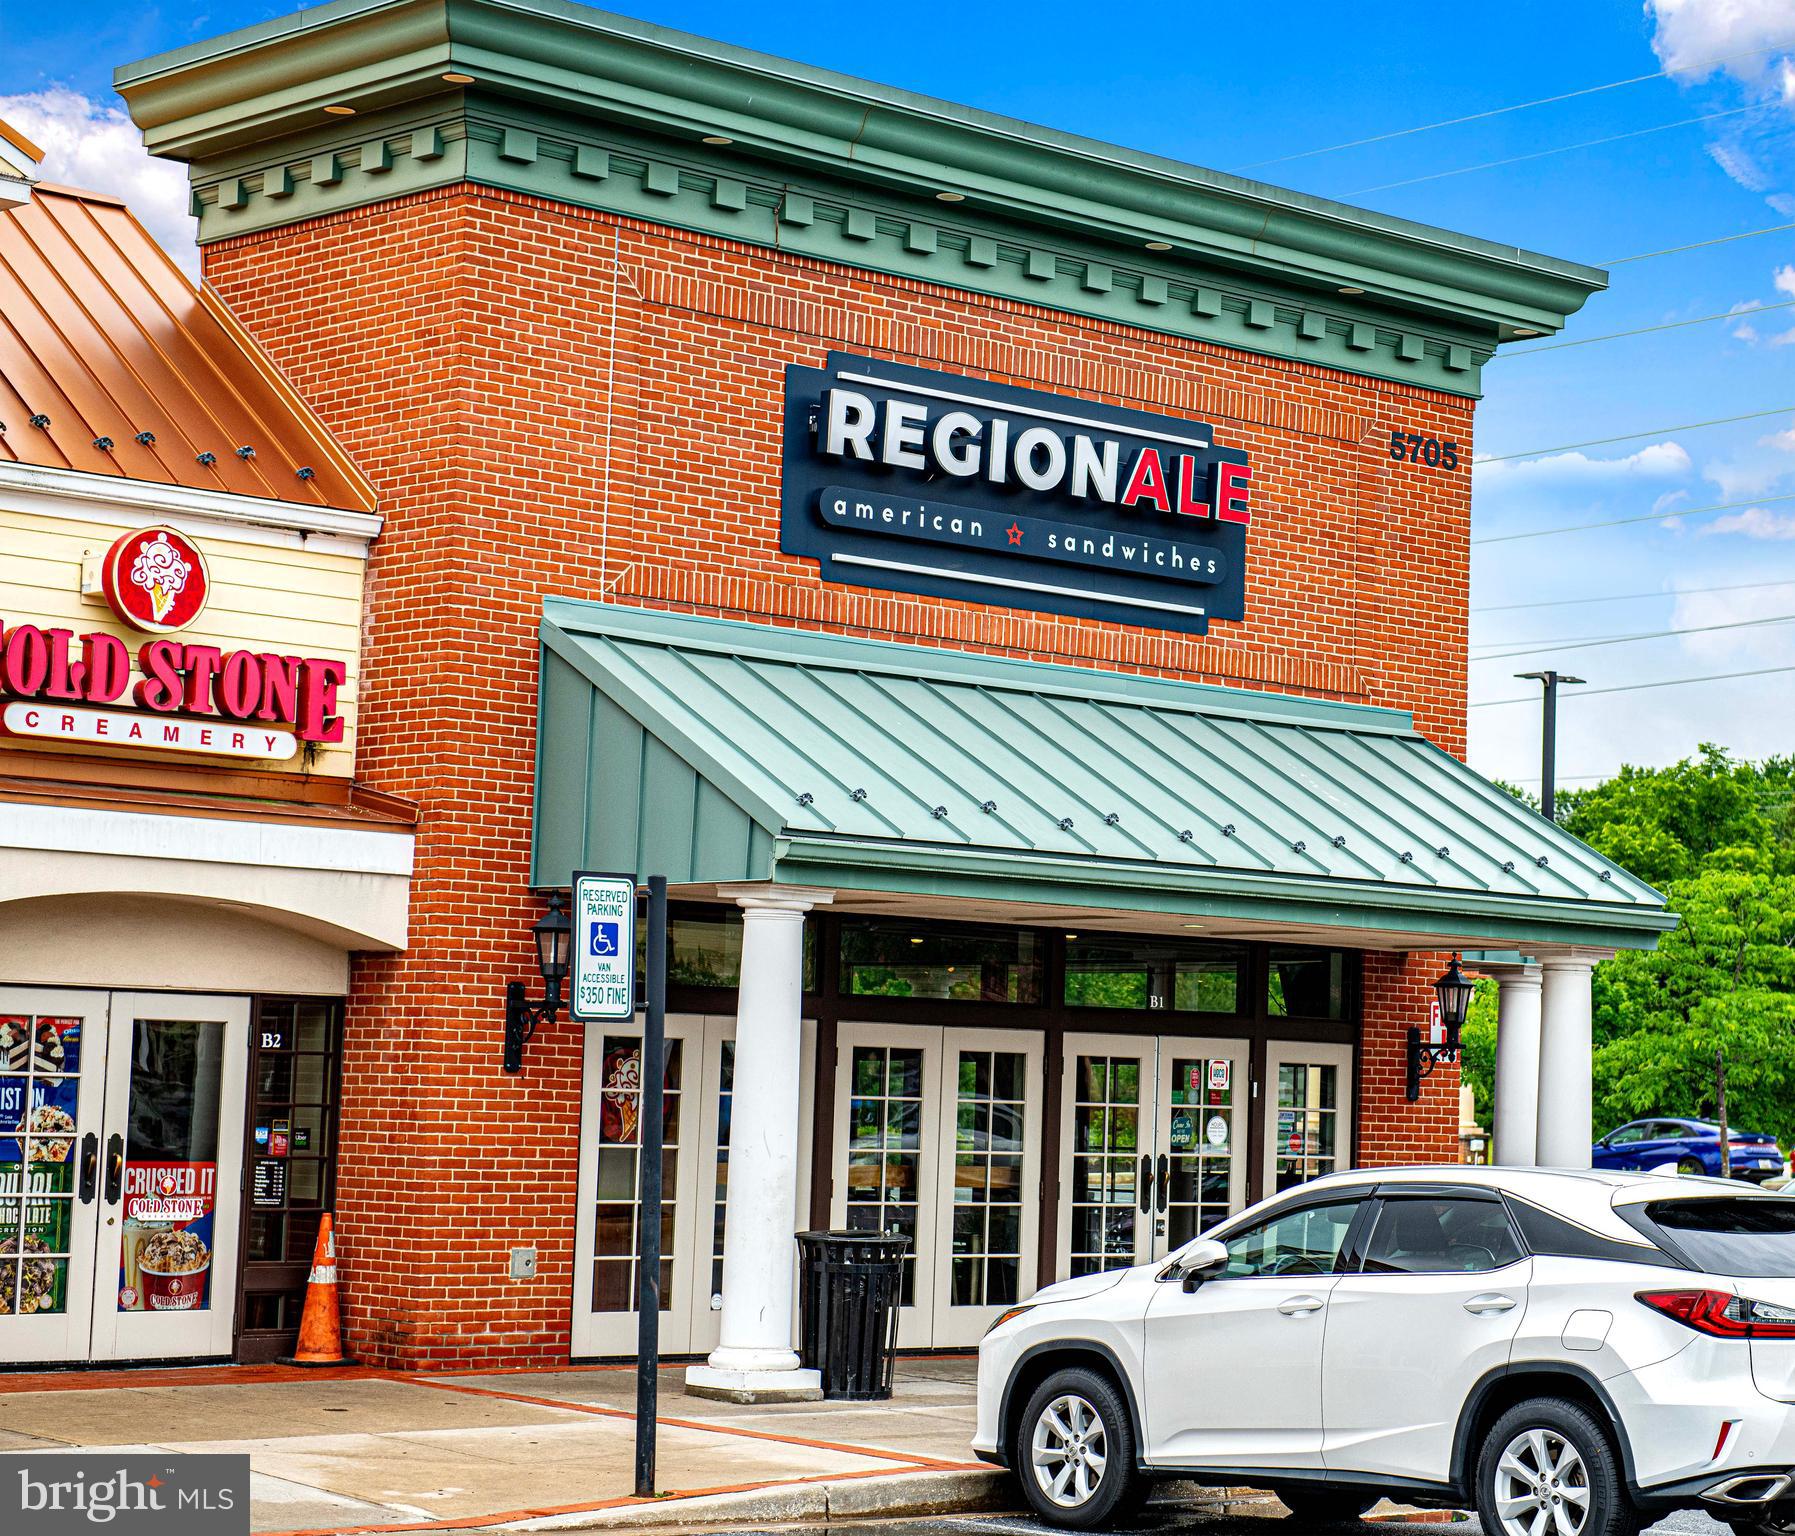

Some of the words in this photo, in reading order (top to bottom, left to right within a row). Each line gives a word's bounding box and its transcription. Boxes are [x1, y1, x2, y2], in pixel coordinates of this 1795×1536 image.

[818, 388, 1253, 525] REGIONALE
[1390, 432, 1458, 470] 5705
[834, 497, 982, 537] american
[1048, 531, 1217, 574] sandwiches
[0, 618, 130, 703] OLD
[133, 640, 347, 743] STONE
[25, 710, 277, 752] CREAMERY
[582, 888, 628, 903] RESERVED
[586, 903, 623, 917] PARKING
[597, 962, 611, 972] VAN
[582, 973, 625, 984] ACCESSIBLE
[580, 986, 604, 1005] $350
[606, 987, 627, 1005] FINE
[1150, 995, 1164, 1008] B1
[261, 1033, 281, 1048] B2
[0, 1087, 21, 1110] IST
[1171, 1134, 1190, 1143] OPEN
[13, 1163, 34, 1171] OR
[200, 1167, 215, 1195] IT
[0, 1207, 52, 1224] HOCLATE
[129, 1199, 161, 1216] COLD
[163, 1199, 203, 1216] STONE
